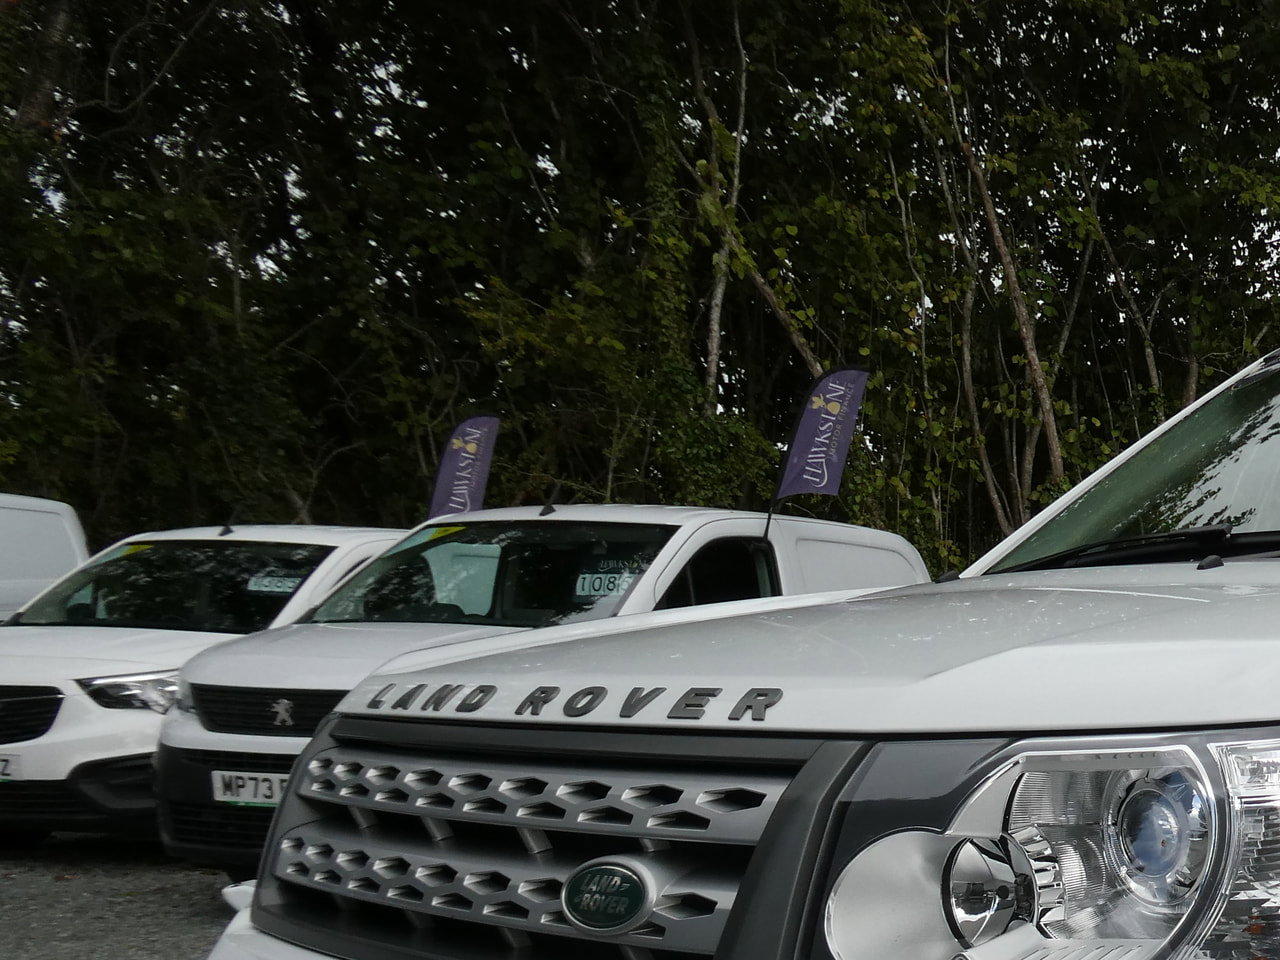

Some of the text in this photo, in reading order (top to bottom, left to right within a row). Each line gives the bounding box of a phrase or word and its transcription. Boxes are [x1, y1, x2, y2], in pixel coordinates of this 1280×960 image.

[366, 683, 783, 721] LAND ROVER
[580, 874, 622, 894] LAND
[580, 893, 629, 914] ROVER
